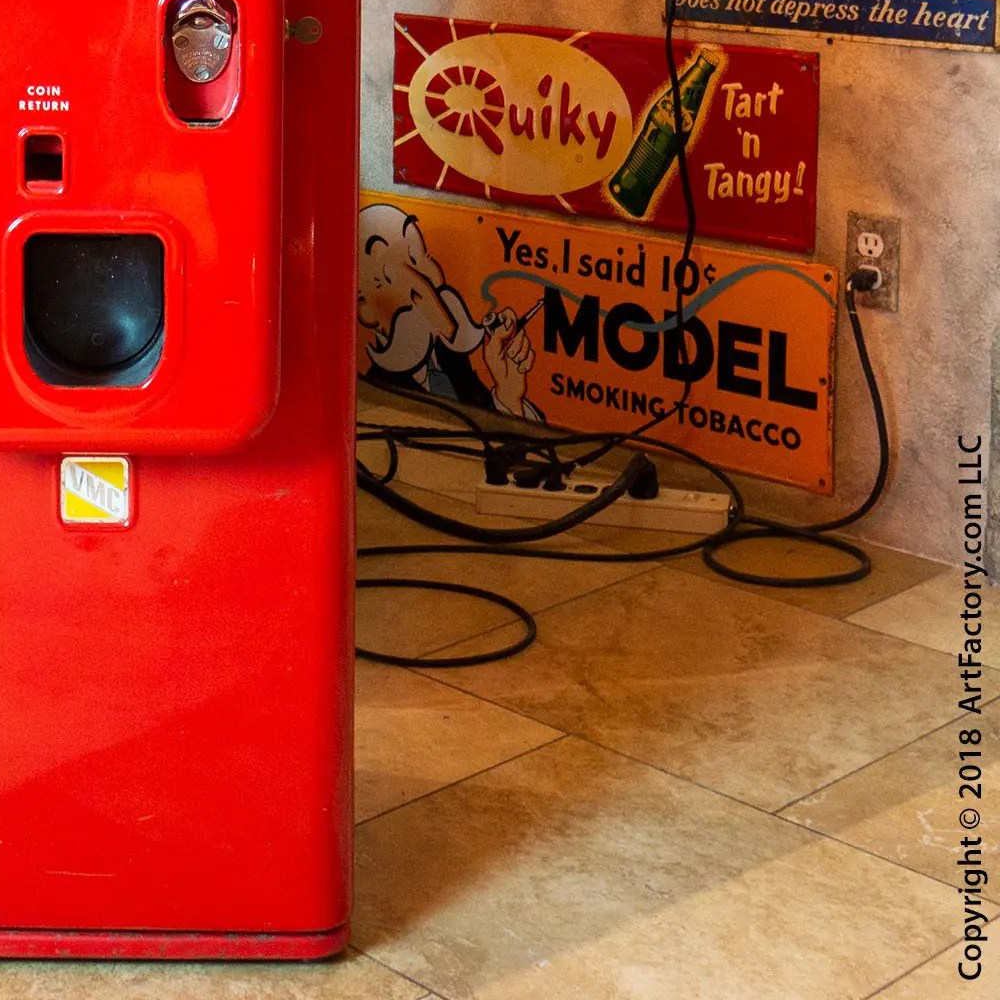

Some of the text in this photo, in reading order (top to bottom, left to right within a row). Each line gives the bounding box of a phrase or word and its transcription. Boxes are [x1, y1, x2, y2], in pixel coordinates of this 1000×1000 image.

[912, 2, 991, 32] heart
[19, 100, 70, 111] RETURN
[27, 85, 61, 97] COIN
[425, 65, 617, 160] Quiky
[721, 82, 784, 121] Tart
[703, 161, 806, 204] Tangy!
[577, 243, 646, 287] said
[543, 285, 818, 411] MODEL
[550, 372, 801, 450] SMOKING TOBACCO
[64, 462, 121, 514] VMC
